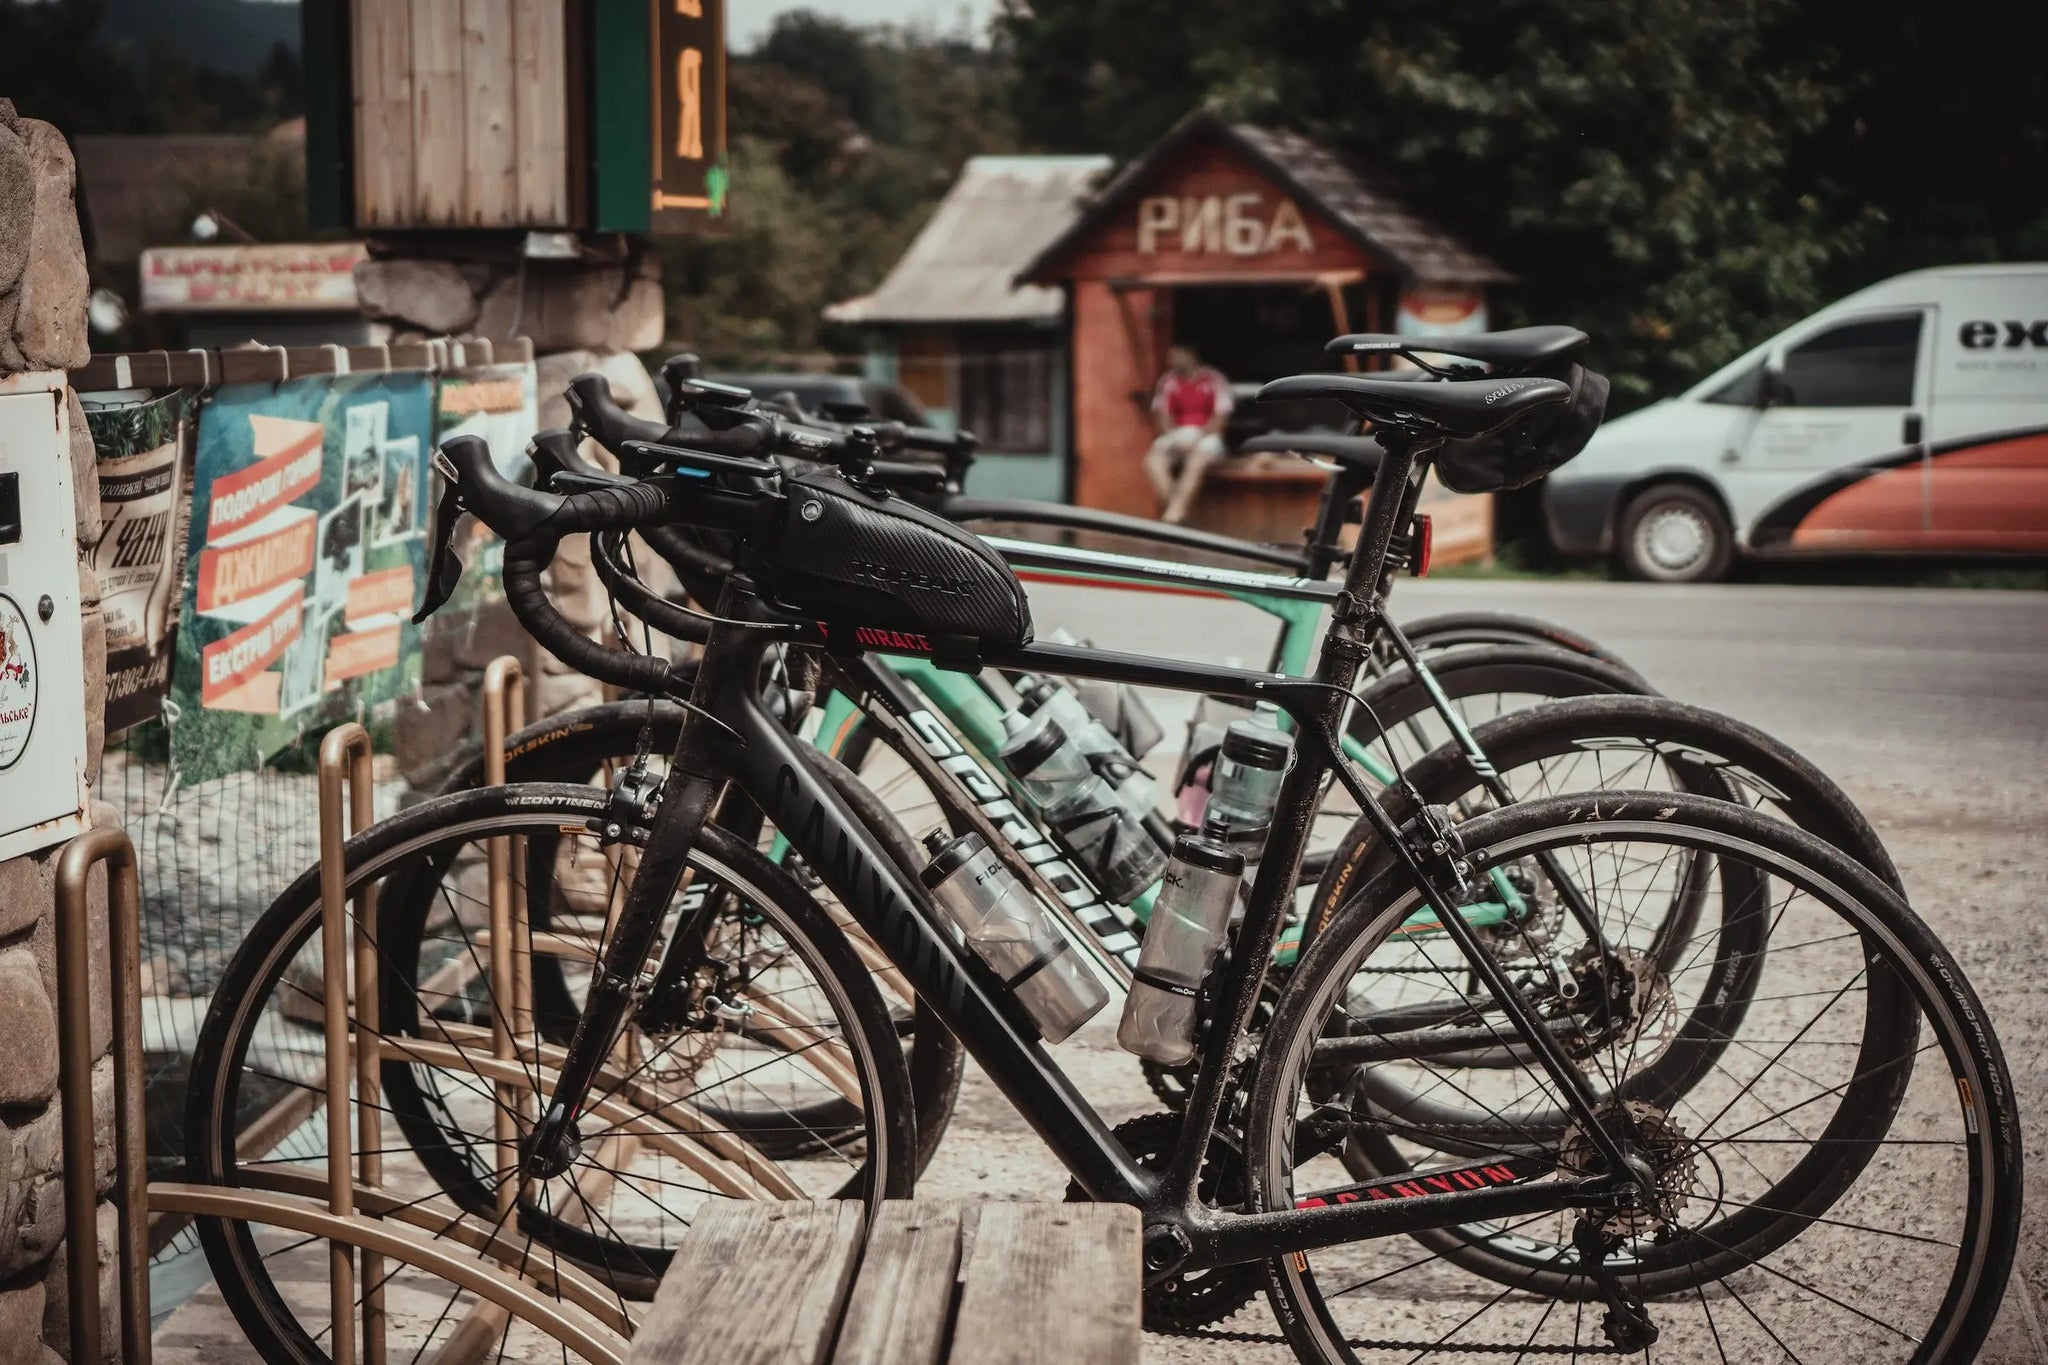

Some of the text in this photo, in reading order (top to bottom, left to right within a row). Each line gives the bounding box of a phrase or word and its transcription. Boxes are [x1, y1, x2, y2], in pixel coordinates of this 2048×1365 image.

[1136, 193, 1314, 255] РИБА
[503, 728, 570, 765] ORSKIN
[975, 862, 1005, 886] FIDL
[1335, 1164, 1517, 1206] CANYON
